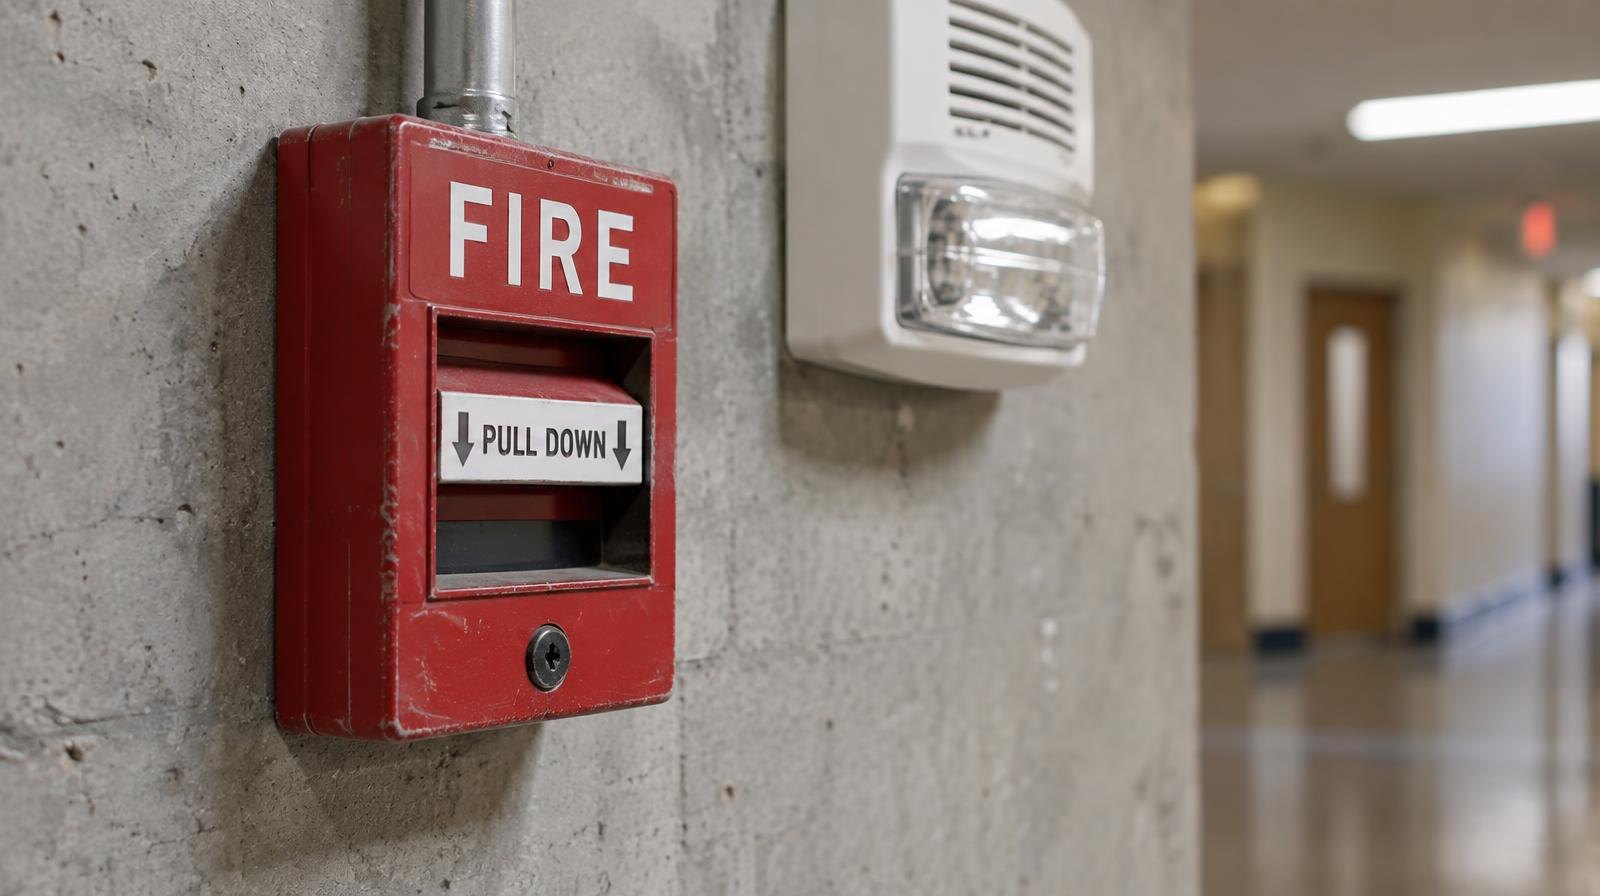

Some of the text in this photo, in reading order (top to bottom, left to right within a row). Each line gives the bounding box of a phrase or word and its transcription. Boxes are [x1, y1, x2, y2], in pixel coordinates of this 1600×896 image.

[450, 181, 634, 301] FIRE
[482, 424, 606, 459] PULL DOWN
